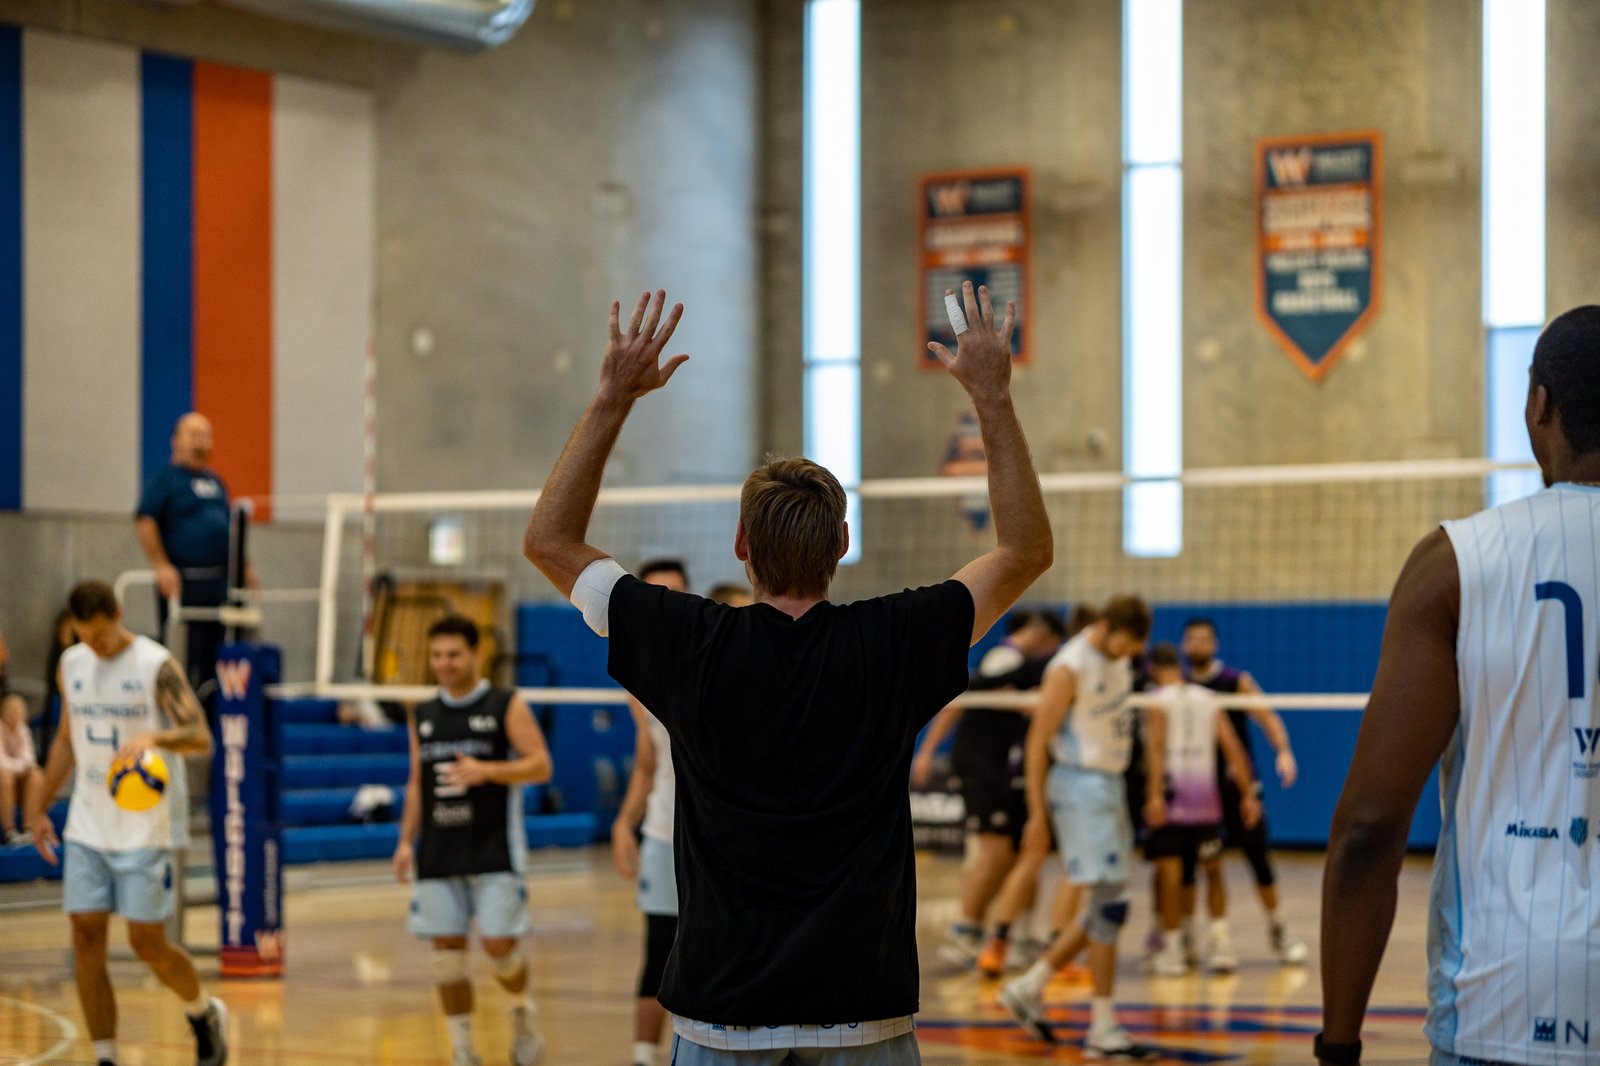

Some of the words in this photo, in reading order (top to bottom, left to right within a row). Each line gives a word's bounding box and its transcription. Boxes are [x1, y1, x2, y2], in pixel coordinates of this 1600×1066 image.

[1535, 581, 1600, 698] 1
[216, 658, 252, 699] W
[86, 724, 118, 751] 4
[1565, 1019, 1589, 1044] N
